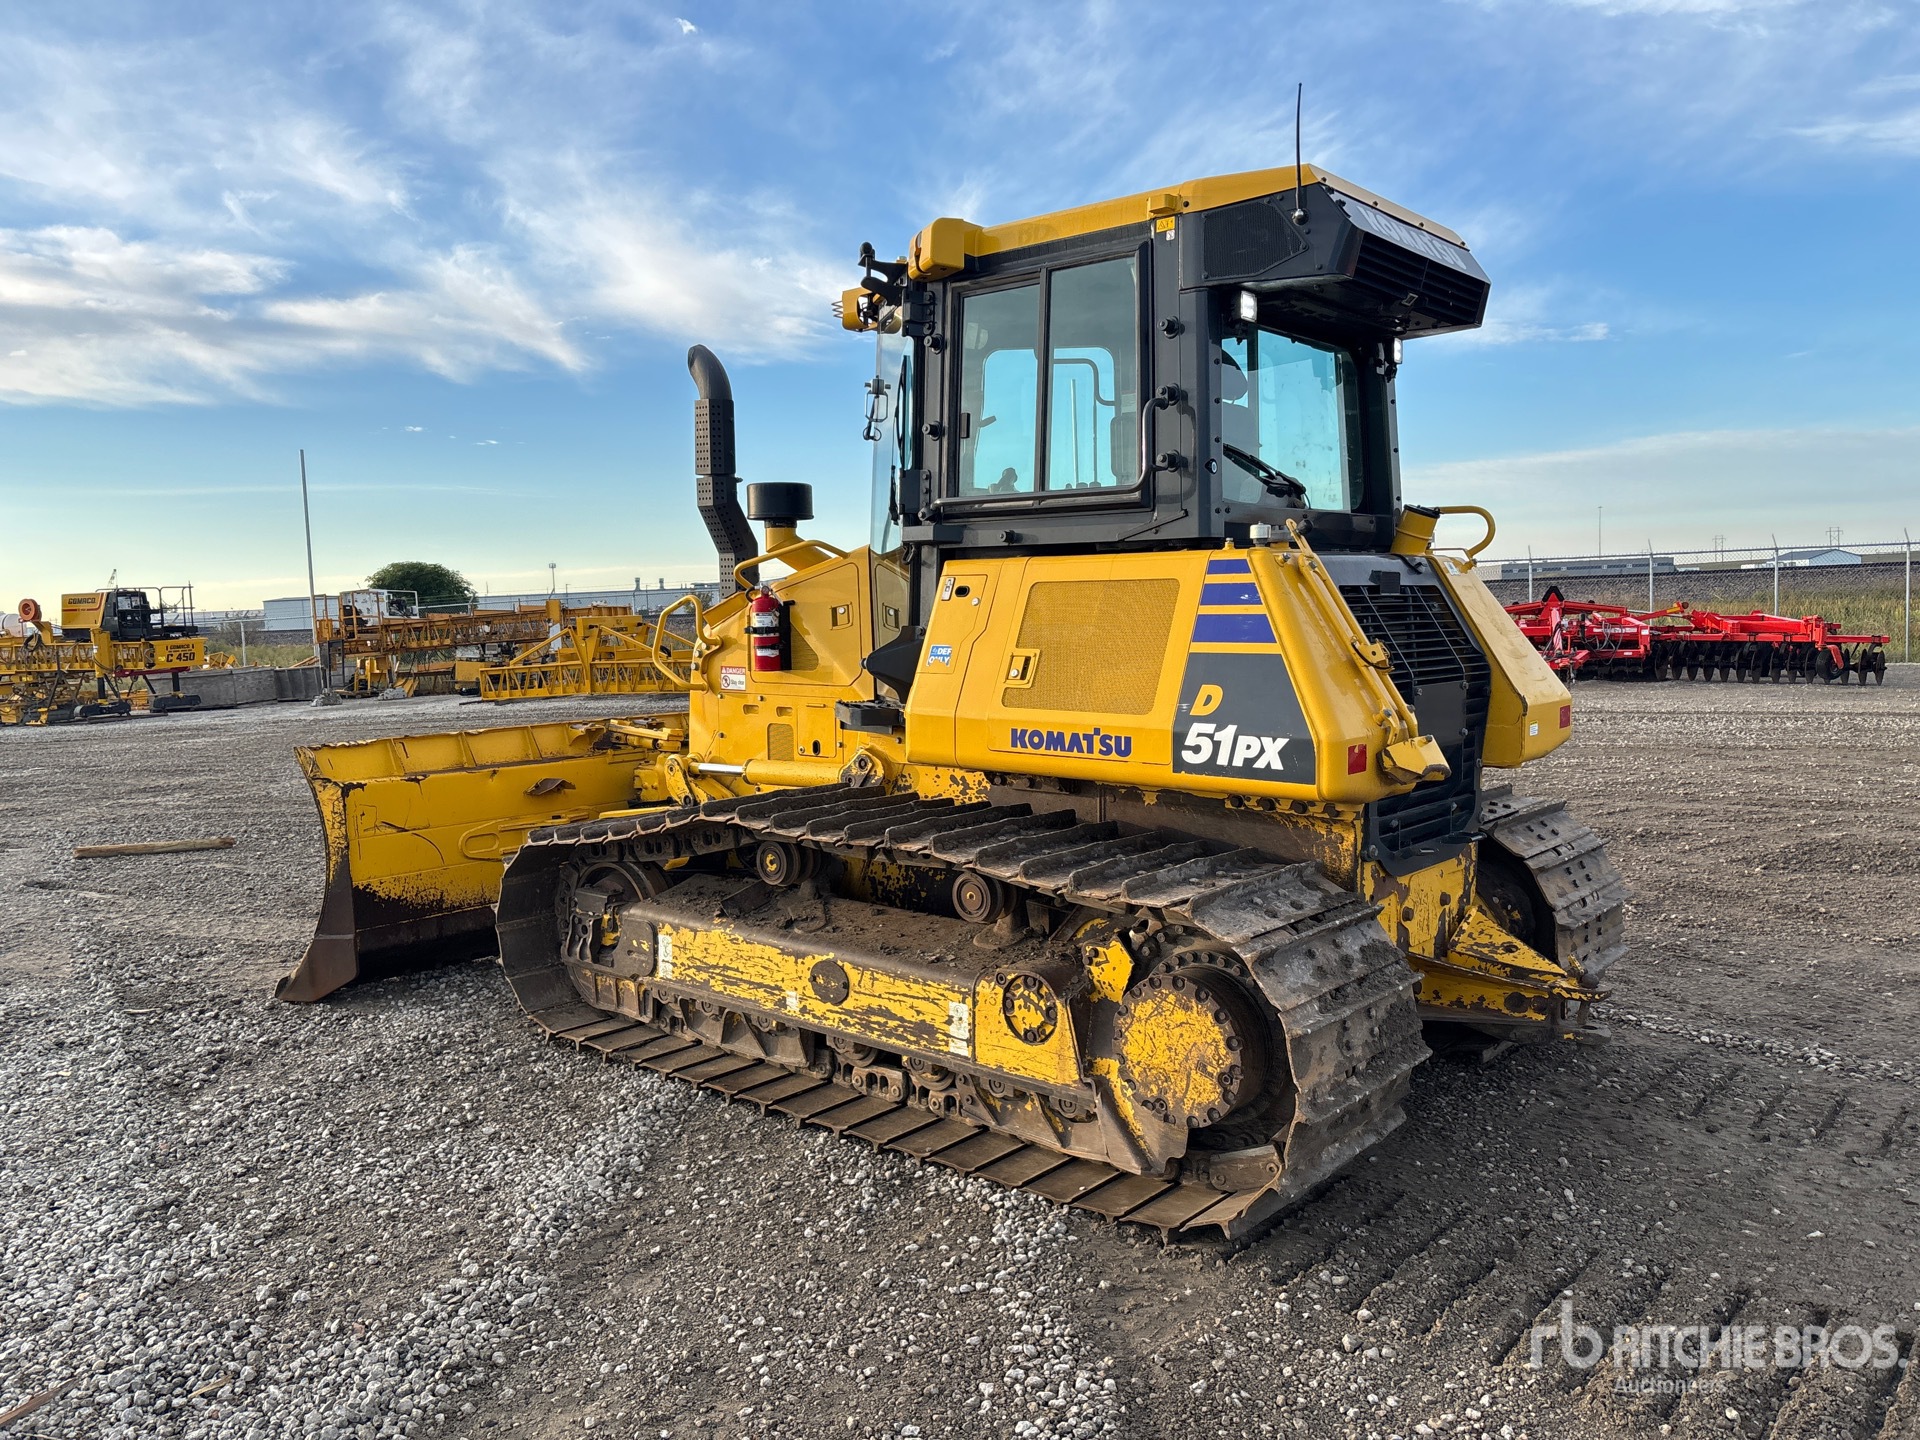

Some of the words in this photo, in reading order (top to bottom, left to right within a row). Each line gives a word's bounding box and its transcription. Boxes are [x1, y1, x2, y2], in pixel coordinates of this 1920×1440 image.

[1356, 205, 1467, 270] KOMATSU
[166, 653, 174, 663] C
[176, 652, 195, 662] 450
[1189, 684, 1224, 716] D
[1011, 727, 1131, 758] KOMATSU
[1181, 722, 1290, 771] 51PX
